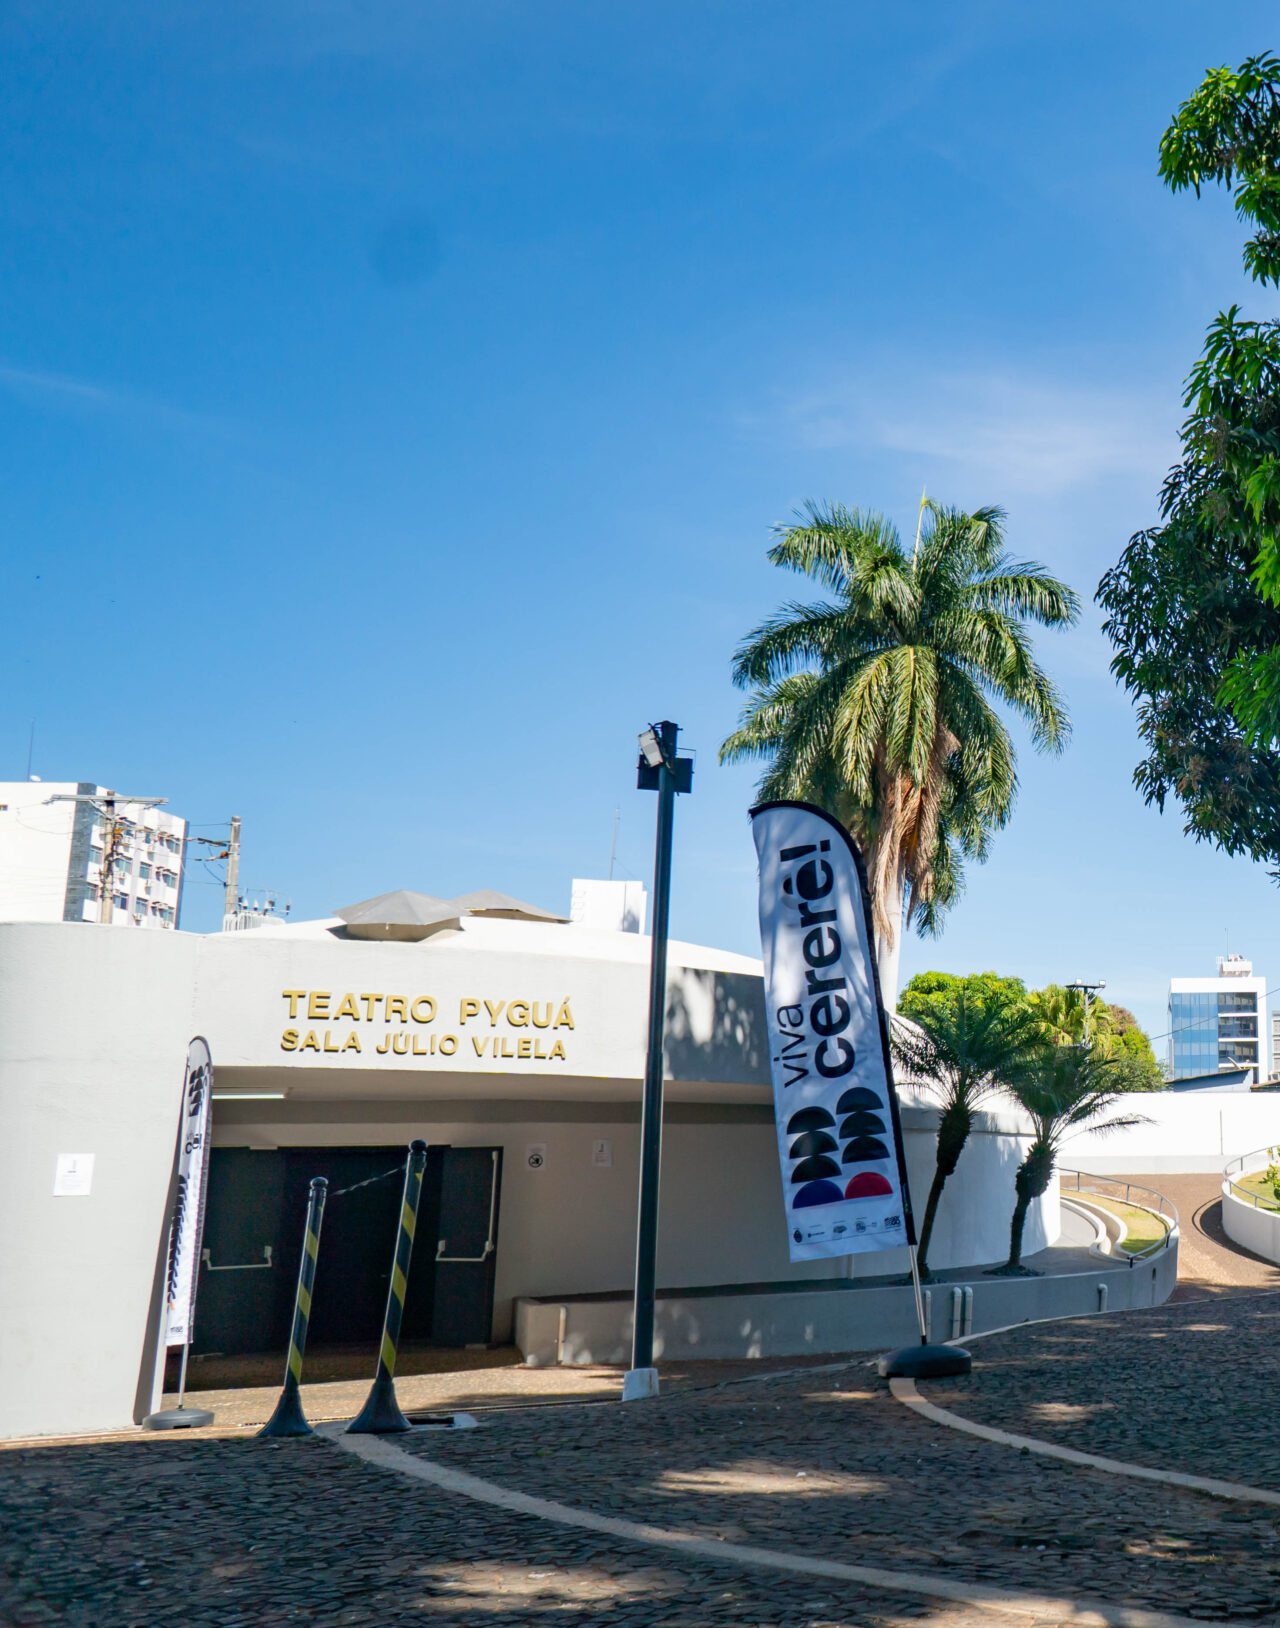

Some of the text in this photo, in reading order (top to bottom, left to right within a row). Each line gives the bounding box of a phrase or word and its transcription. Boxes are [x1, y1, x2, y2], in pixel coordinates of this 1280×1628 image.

[780, 839, 856, 1079] cererê!
[282, 990, 575, 1030] TEATRO PYGUÁ
[280, 1029, 566, 1060] SALA JÚLIO VILELA
[774, 1003, 810, 1088] viva
